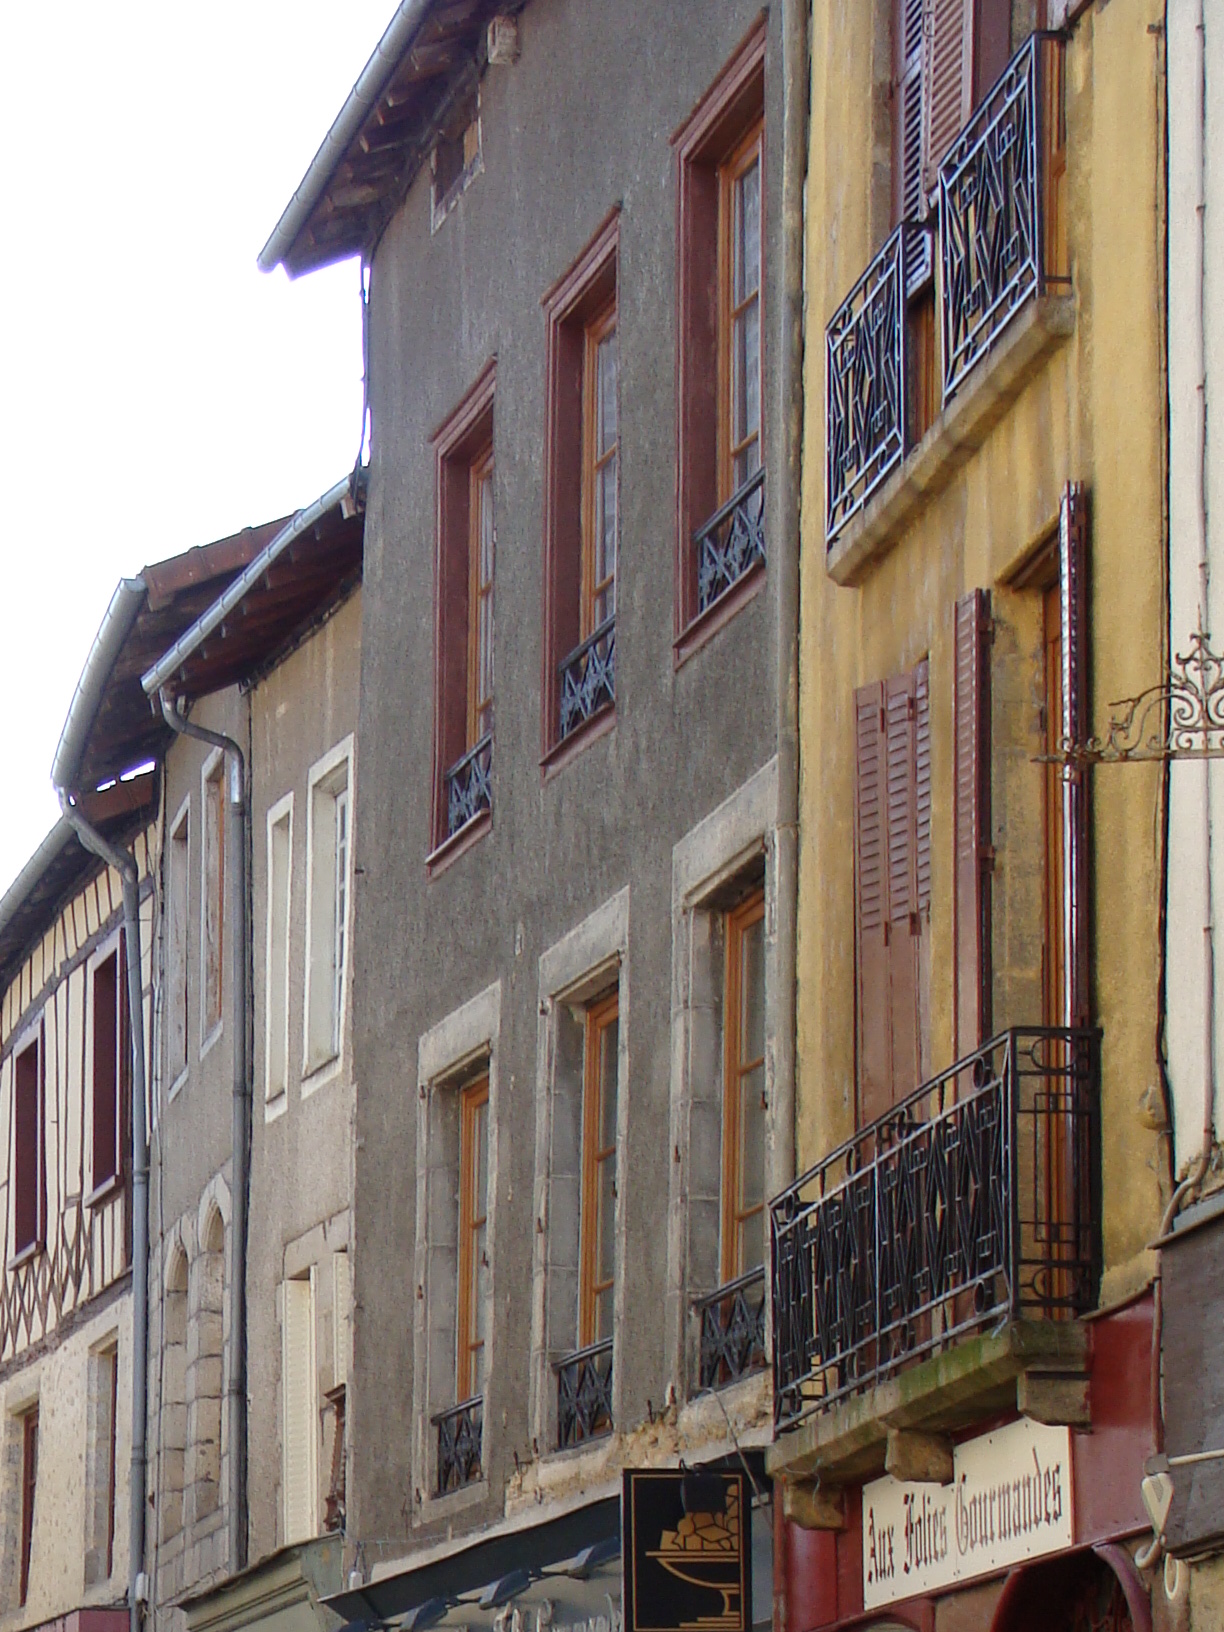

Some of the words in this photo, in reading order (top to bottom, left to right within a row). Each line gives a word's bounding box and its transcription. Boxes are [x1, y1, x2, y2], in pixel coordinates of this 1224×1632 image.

[868, 1507, 894, 1584] Aux
[904, 1491, 947, 1574] Folies
[955, 1446, 1062, 1556] Gourmandes
